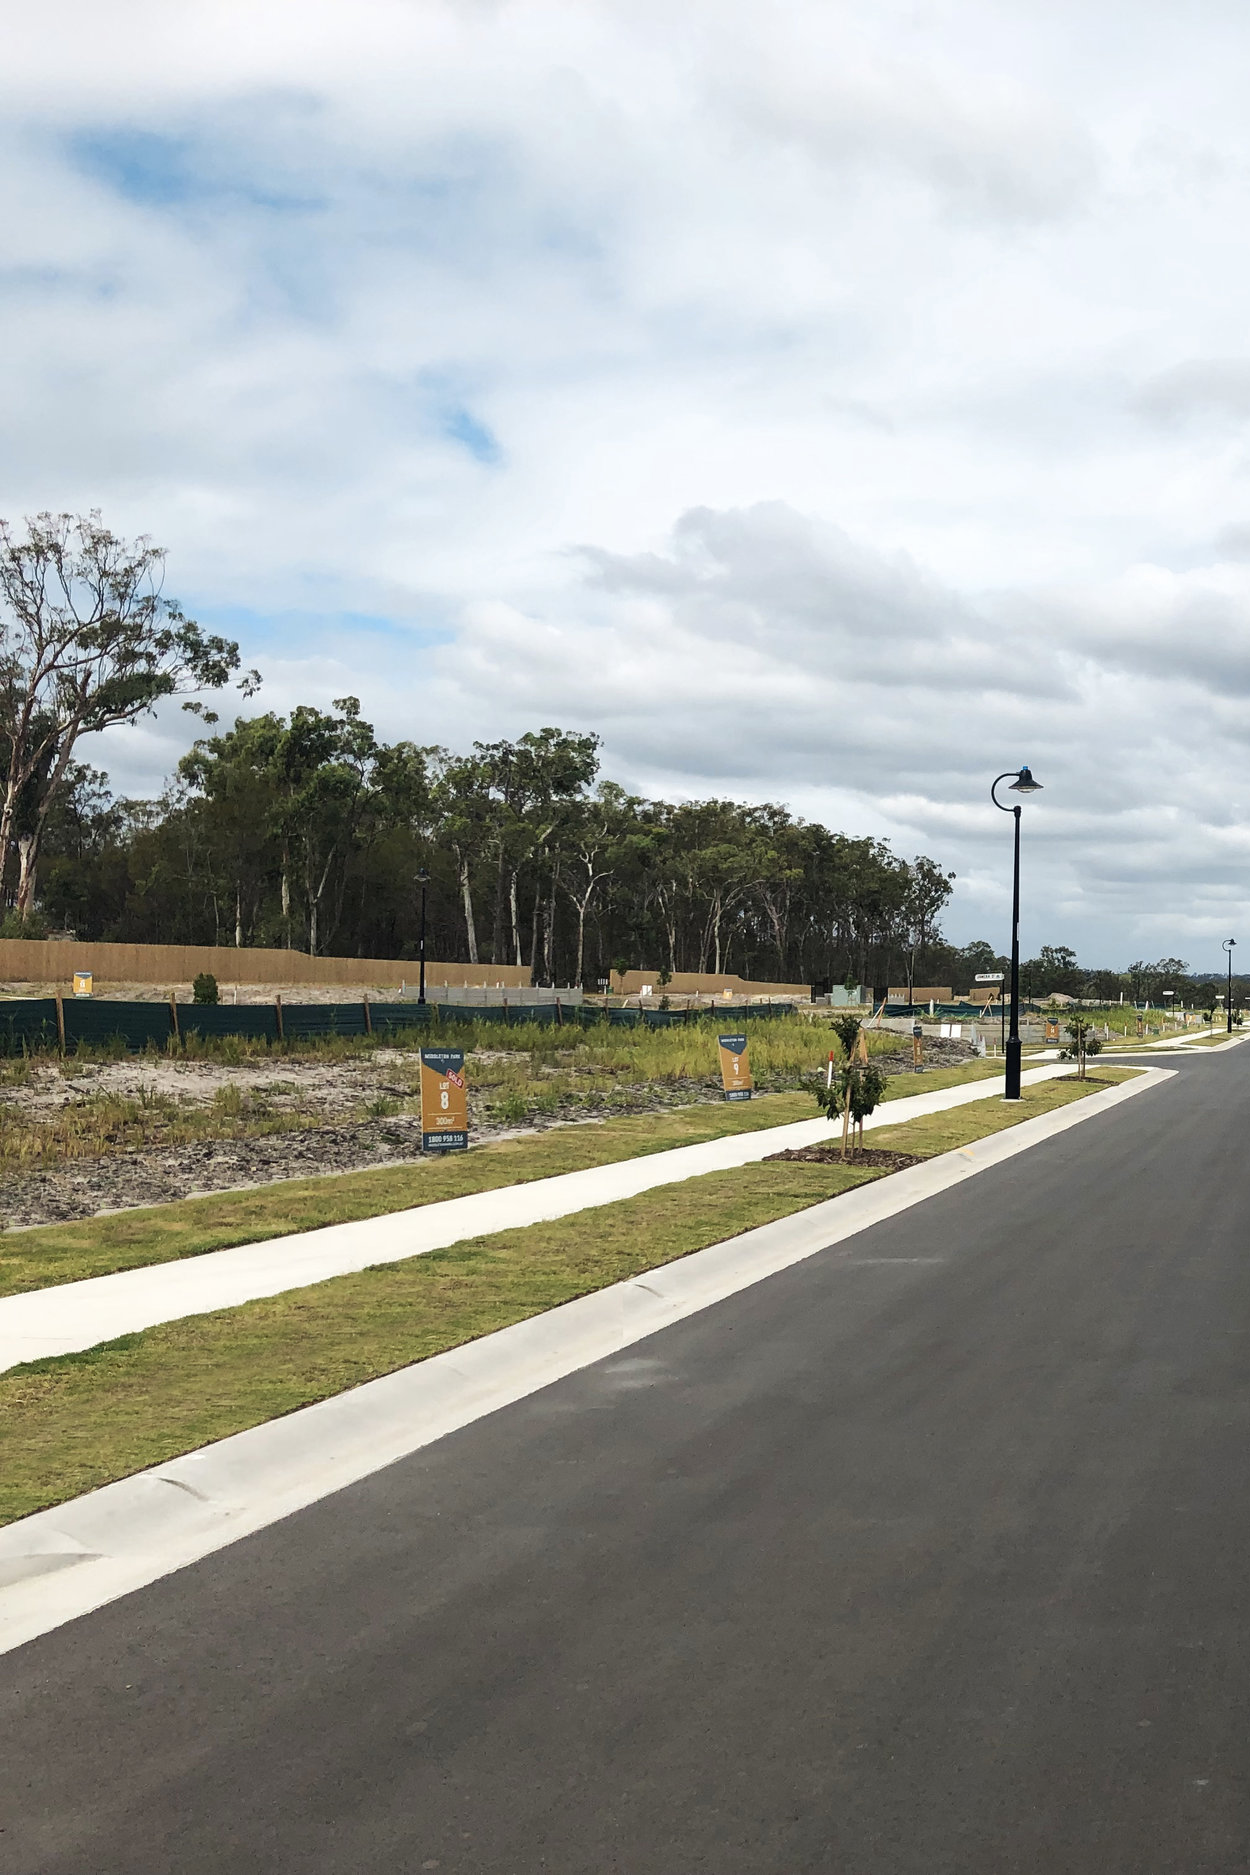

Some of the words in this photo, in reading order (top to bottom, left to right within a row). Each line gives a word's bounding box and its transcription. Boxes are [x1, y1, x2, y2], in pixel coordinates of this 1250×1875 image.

[448, 1070, 463, 1087] SOLD
[440, 1082, 450, 1090] LOT
[441, 1091, 449, 1110] 8
[454, 1134, 464, 1142] 116
